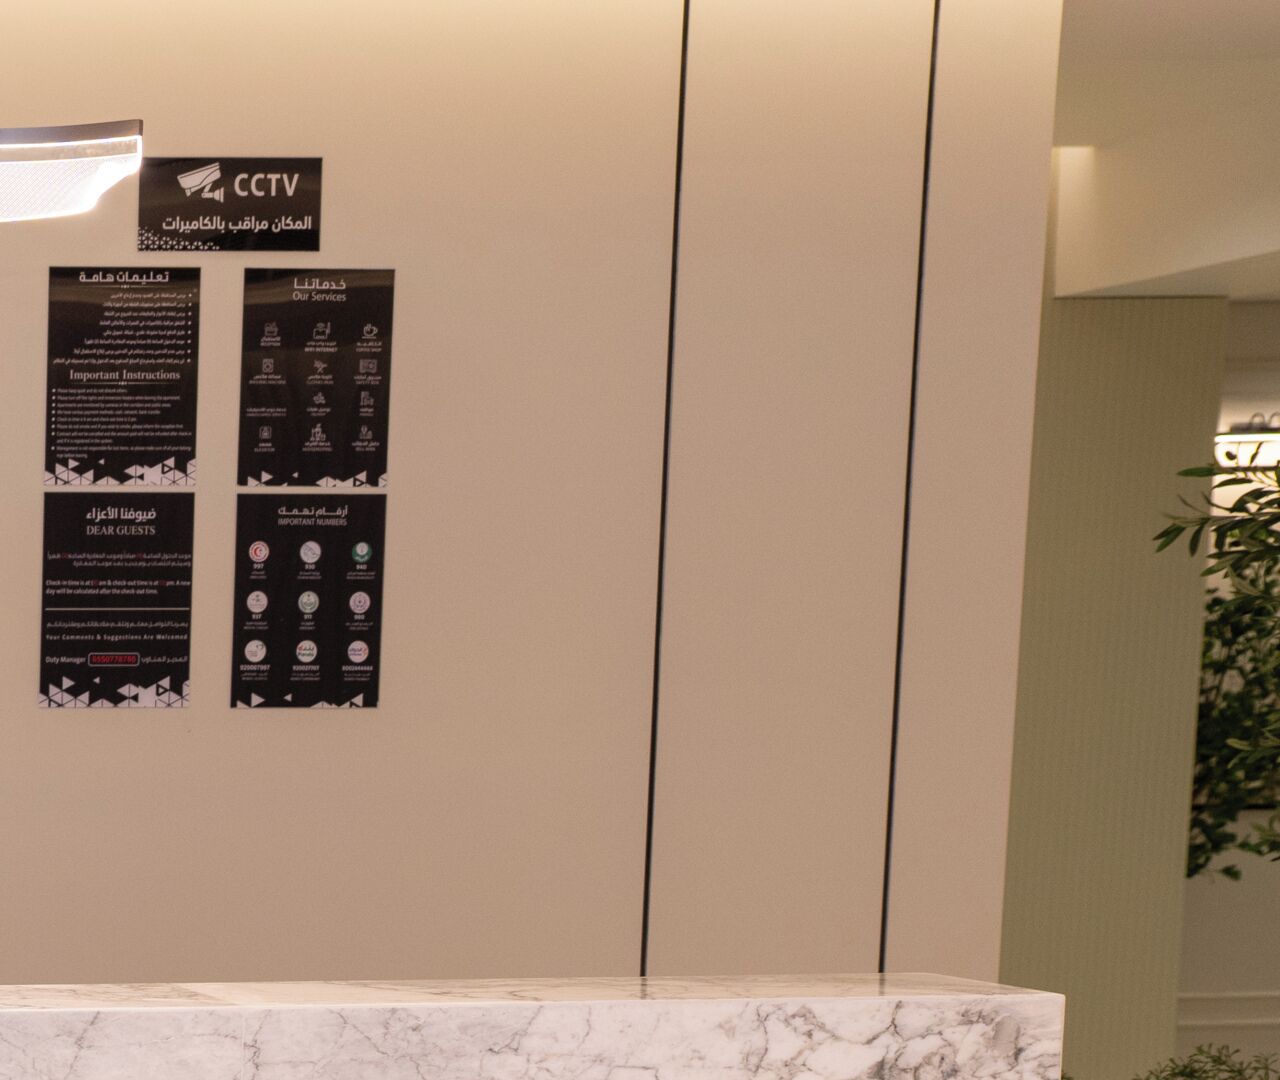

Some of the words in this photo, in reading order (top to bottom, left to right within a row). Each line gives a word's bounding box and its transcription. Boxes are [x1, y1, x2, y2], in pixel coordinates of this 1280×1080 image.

[234, 172, 299, 198] CCTV
[162, 215, 225, 232] بالكاميرات
[228, 216, 269, 233] مراقب
[271, 216, 312, 232] المكان
[79, 272, 114, 283] هامة
[117, 271, 169, 284] تعليمات
[293, 277, 346, 290] خدماتنا
[292, 291, 309, 301] Our
[312, 291, 346, 301] Services
[70, 369, 119, 381] Important
[122, 369, 181, 380] Instructions
[86, 506, 118, 522] الأعزاء
[120, 507, 157, 523] ضيوفنا
[277, 506, 315, 515] تهمك
[315, 505, 348, 518] أرقام
[278, 518, 316, 526] IMPORTANT
[316, 518, 347, 526] NUMBERS
[86, 526, 114, 535] DEAR
[116, 526, 156, 535] GUESTS
[103, 633, 142, 642] Suggestions
[45, 656, 60, 664] Duty
[60, 656, 86, 664] Manager
